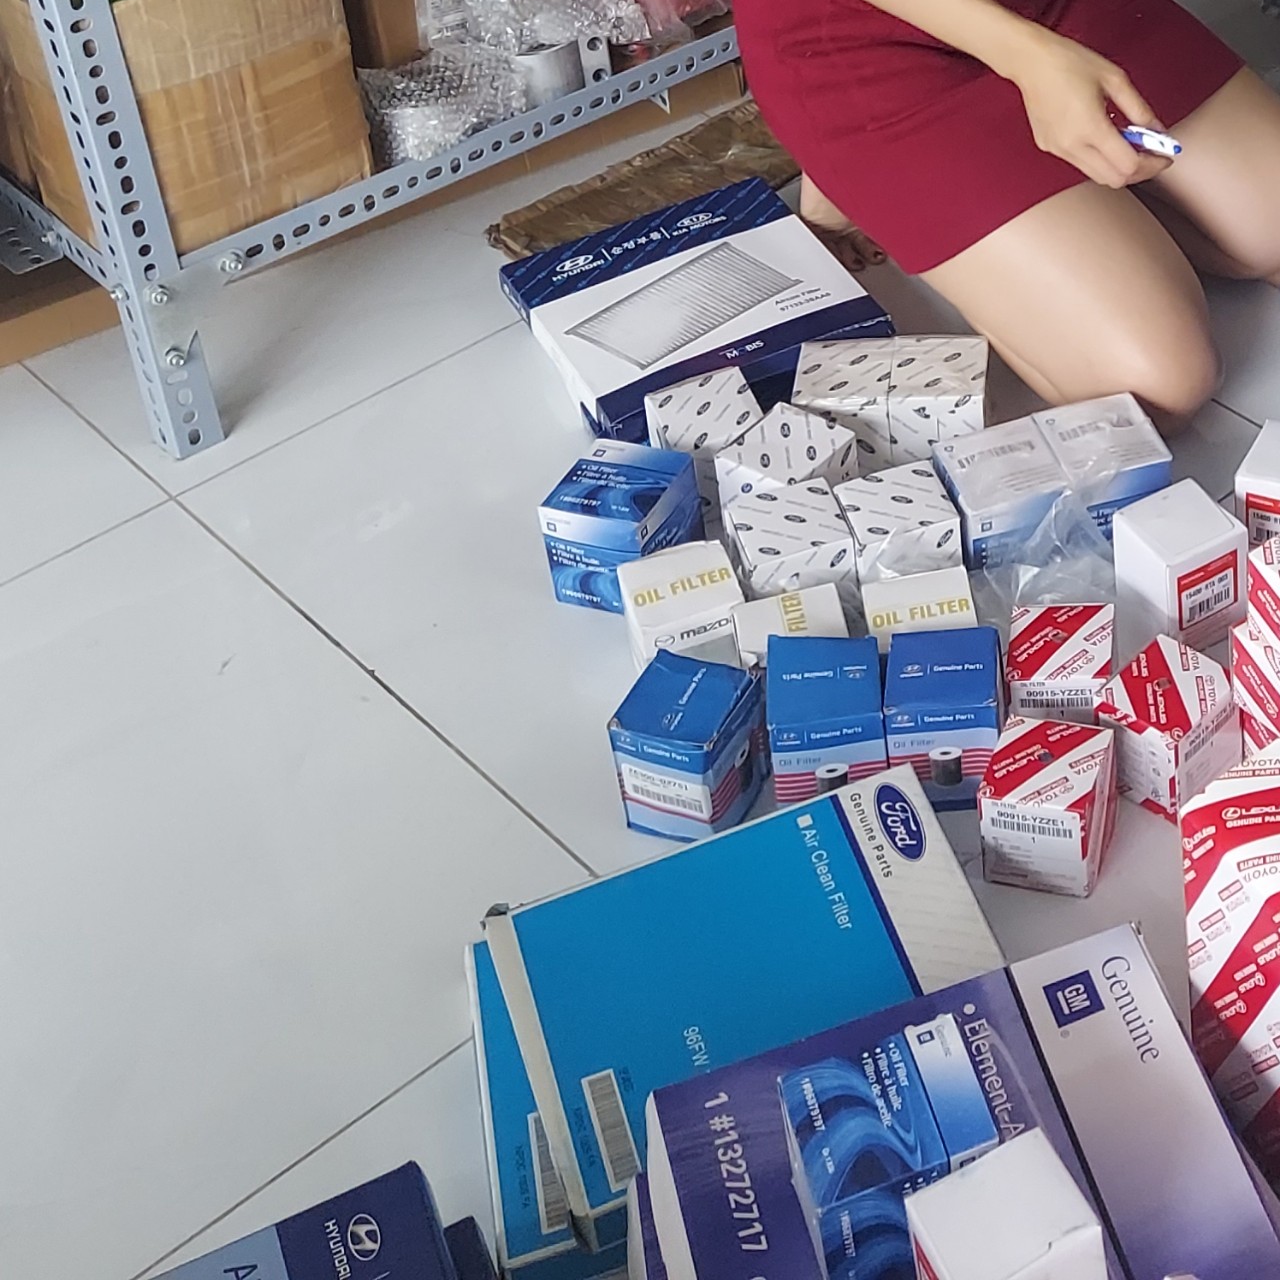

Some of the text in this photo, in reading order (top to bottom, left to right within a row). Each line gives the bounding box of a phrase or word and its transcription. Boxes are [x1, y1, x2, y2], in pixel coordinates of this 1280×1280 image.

[672, 215, 727, 236] KIA MOTORS
[551, 258, 605, 282] HYUNDAI
[726, 340, 765, 360] MOBIS
[633, 568, 732, 607] OIL FILTER
[872, 597, 970, 628] OIL FILTER
[680, 618, 732, 641] mazd
[933, 661, 984, 673] Genuine Parts
[1026, 688, 1093, 698] 90915-YZZE1
[924, 712, 975, 724] Genuine Parts
[810, 726, 863, 742] Genuine Parts
[881, 802, 917, 849] Ford
[997, 810, 1065, 827] 90915-YZZE1
[850, 792, 893, 879] Genuine Parts
[801, 828, 852, 929] Air Clean Filter
[1101, 955, 1160, 1064] Genuine
[963, 1018, 1026, 1138] Element-A
[704, 1091, 768, 1251] 1 #13272717
